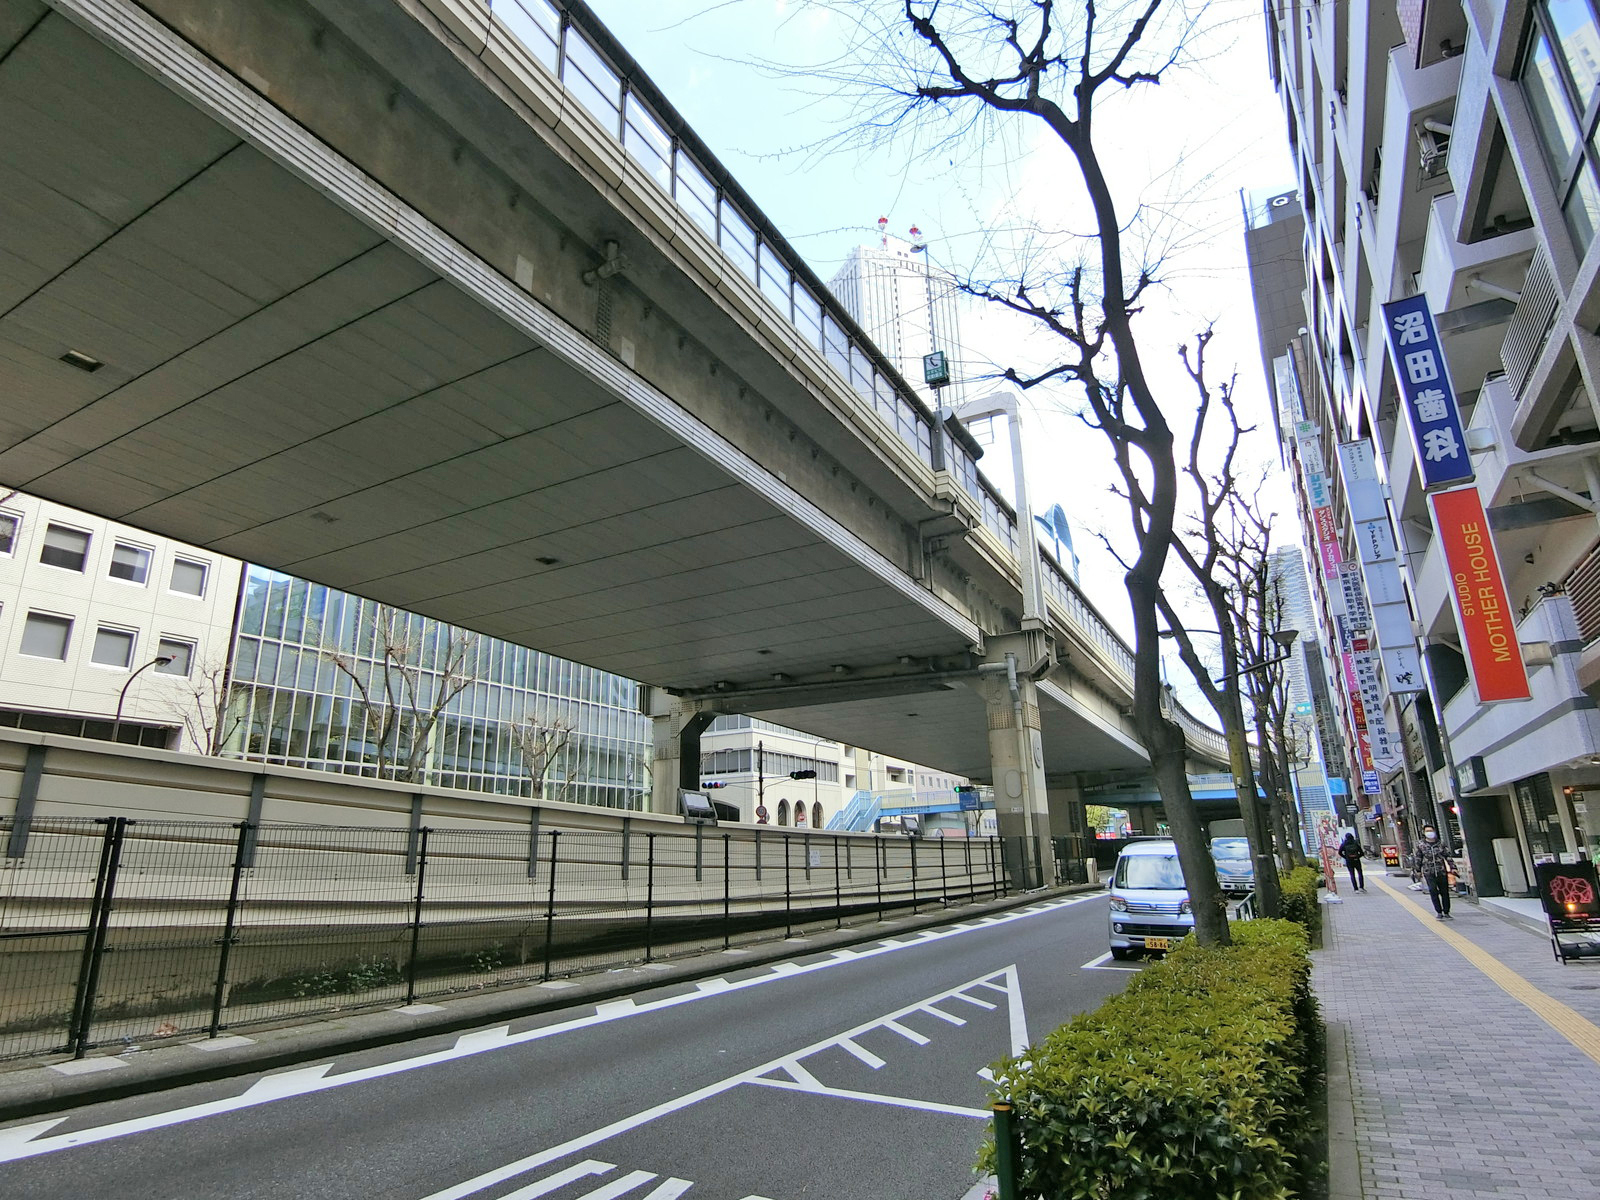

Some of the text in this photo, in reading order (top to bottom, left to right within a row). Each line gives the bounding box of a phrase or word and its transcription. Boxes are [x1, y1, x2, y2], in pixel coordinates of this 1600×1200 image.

[1394, 310, 1460, 463] 沼田歯科
[1454, 572, 1475, 617] STUDIO
[1461, 521, 1512, 663] MOTHER HOUSE
